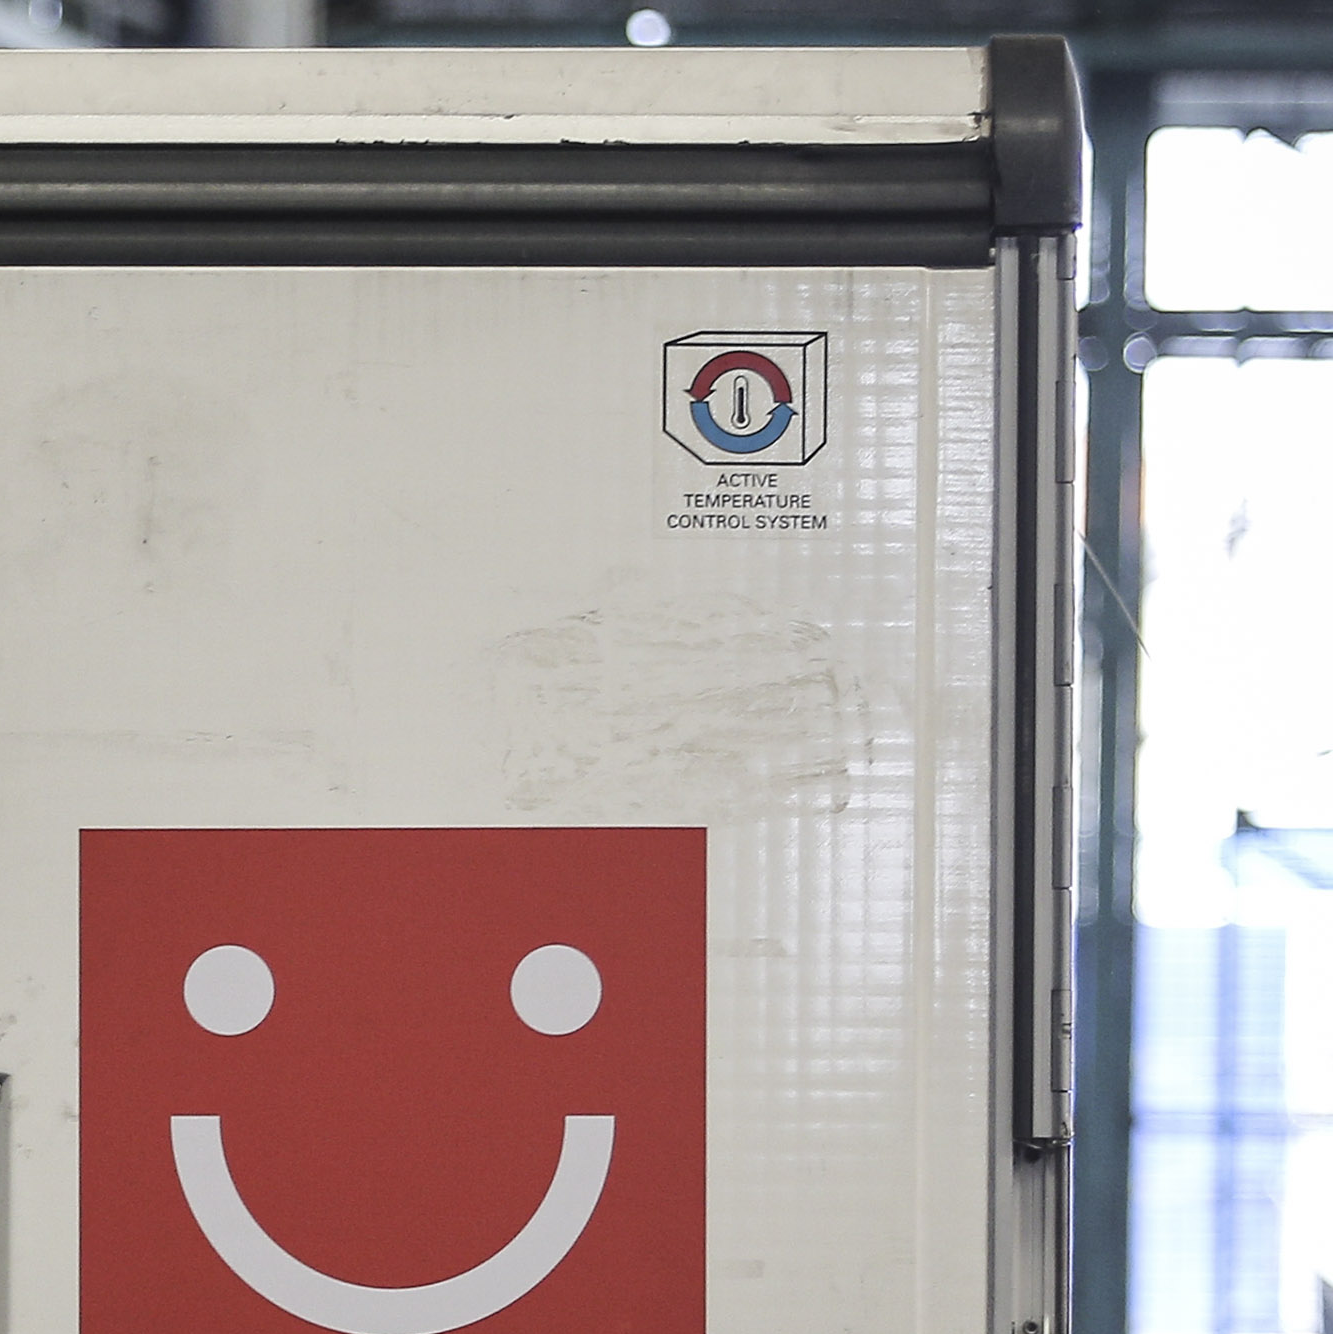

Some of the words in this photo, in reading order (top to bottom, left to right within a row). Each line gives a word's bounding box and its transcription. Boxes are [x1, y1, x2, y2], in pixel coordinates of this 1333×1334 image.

[716, 472, 778, 488] ACTIVE
[683, 493, 812, 509] TEMPERATURE
[666, 514, 751, 530] CONTROL
[755, 514, 828, 530] SYSTEM
